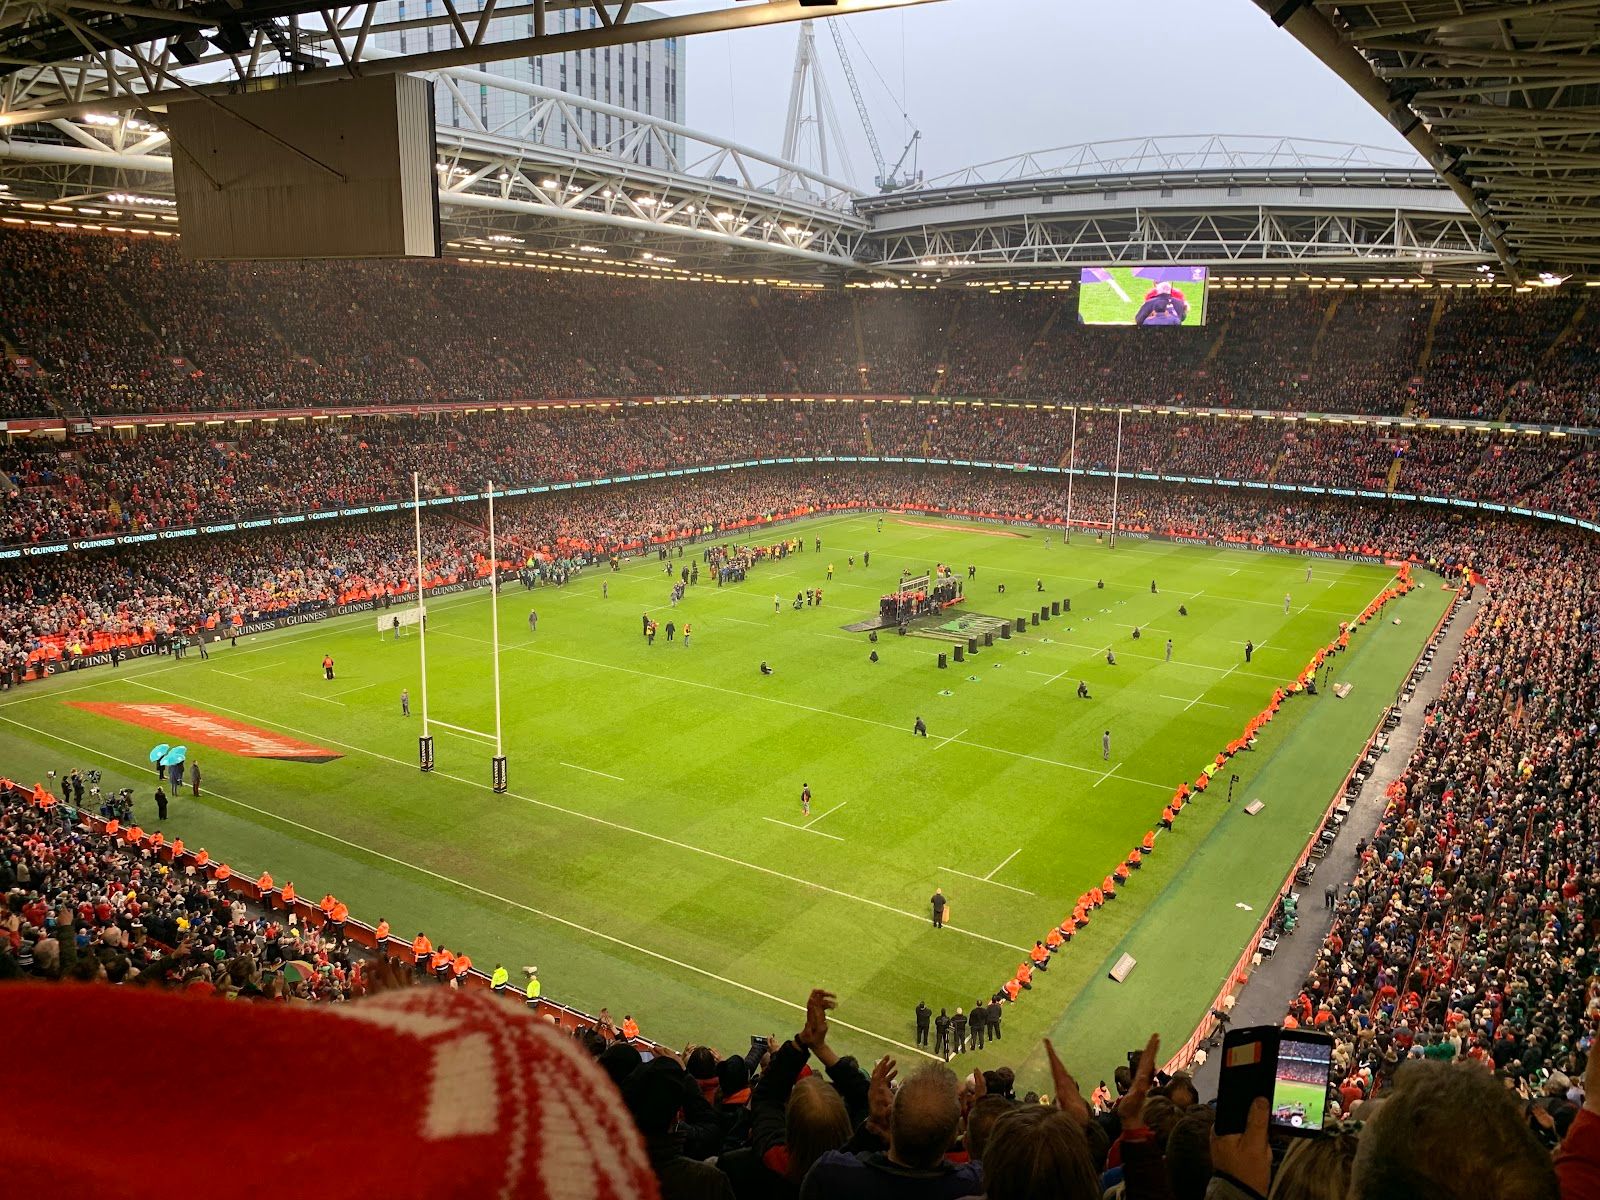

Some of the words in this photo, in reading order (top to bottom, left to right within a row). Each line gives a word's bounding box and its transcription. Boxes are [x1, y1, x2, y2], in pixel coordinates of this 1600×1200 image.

[30, 544, 68, 555] GUINNESS
[80, 538, 115, 549] GUINNESS
[124, 534, 158, 544] GUINNESS
[165, 528, 197, 538] GUINNESS
[206, 524, 236, 533] GUINNESS
[243, 520, 272, 528] GUINNESS
[278, 516, 304, 524] GUINNESS
[1120, 530, 1149, 539] GUINNESS
[1176, 536, 1206, 546] GUINNESS
[1216, 540, 1248, 550] GUINNESS
[1256, 544, 1290, 554] GUINNESS
[1301, 549, 1336, 559] GUINNESS
[1344, 554, 1380, 564] GUINNESS
[286, 611, 328, 626] GUINNESS
[432, 584, 464, 596] GUINNESS
